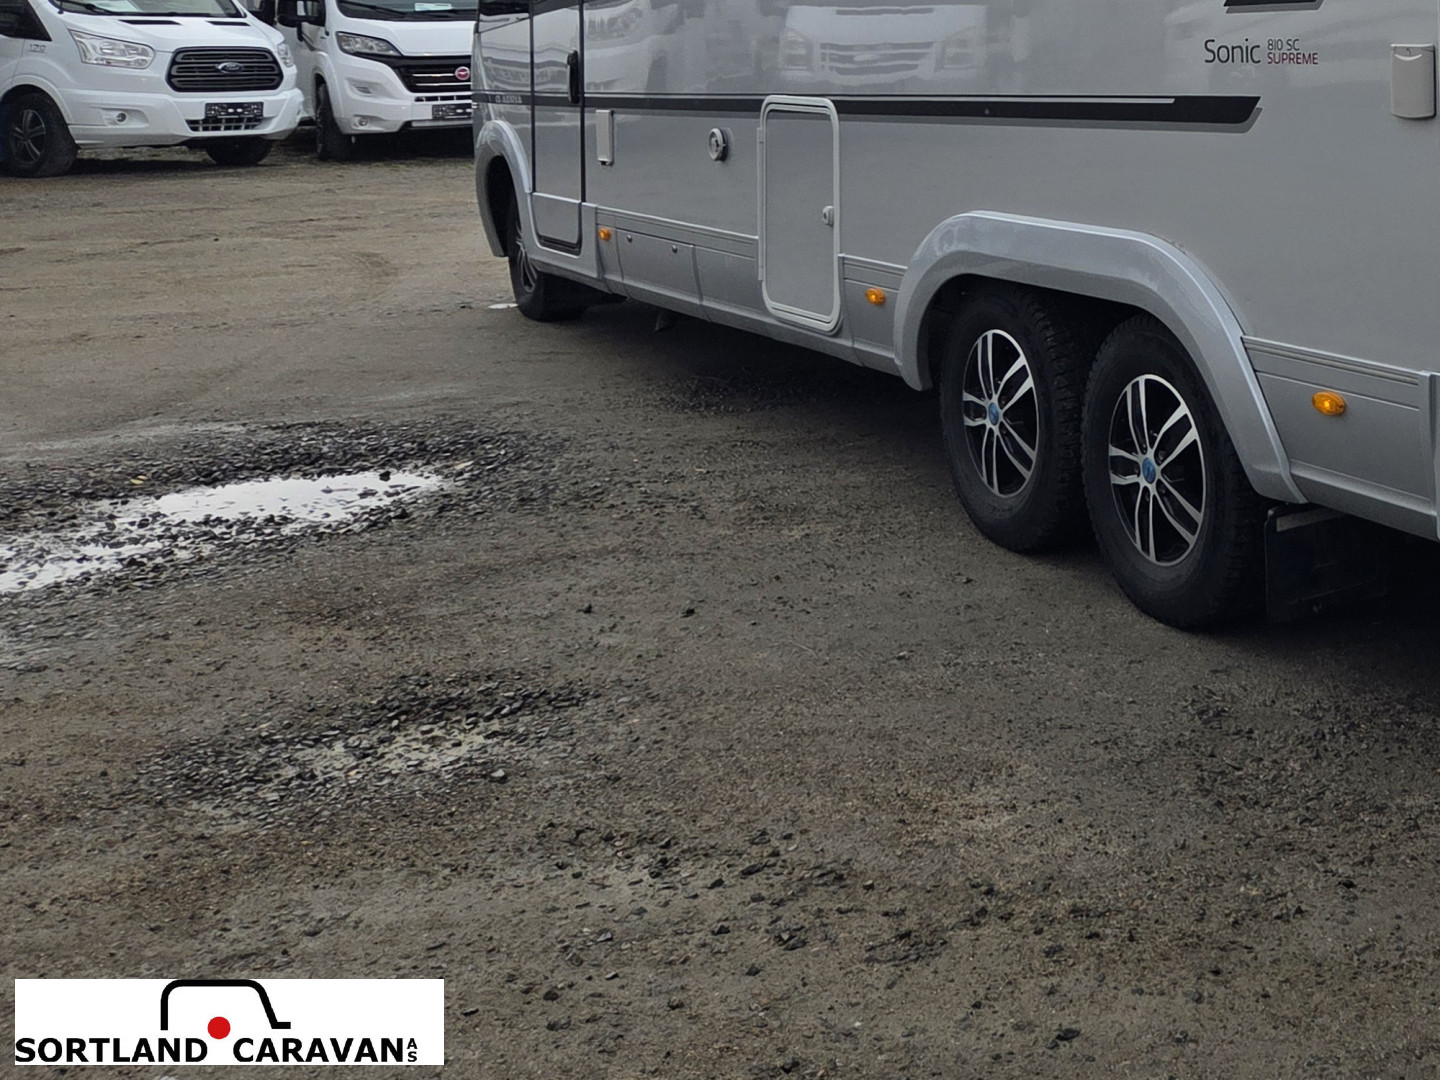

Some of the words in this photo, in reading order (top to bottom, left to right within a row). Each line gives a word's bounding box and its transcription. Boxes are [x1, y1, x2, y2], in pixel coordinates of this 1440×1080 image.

[1204, 38, 1261, 64] Sonic
[1267, 39, 1283, 51] 810
[1287, 39, 1300, 51] SC
[1267, 52, 1318, 64] SUPREME
